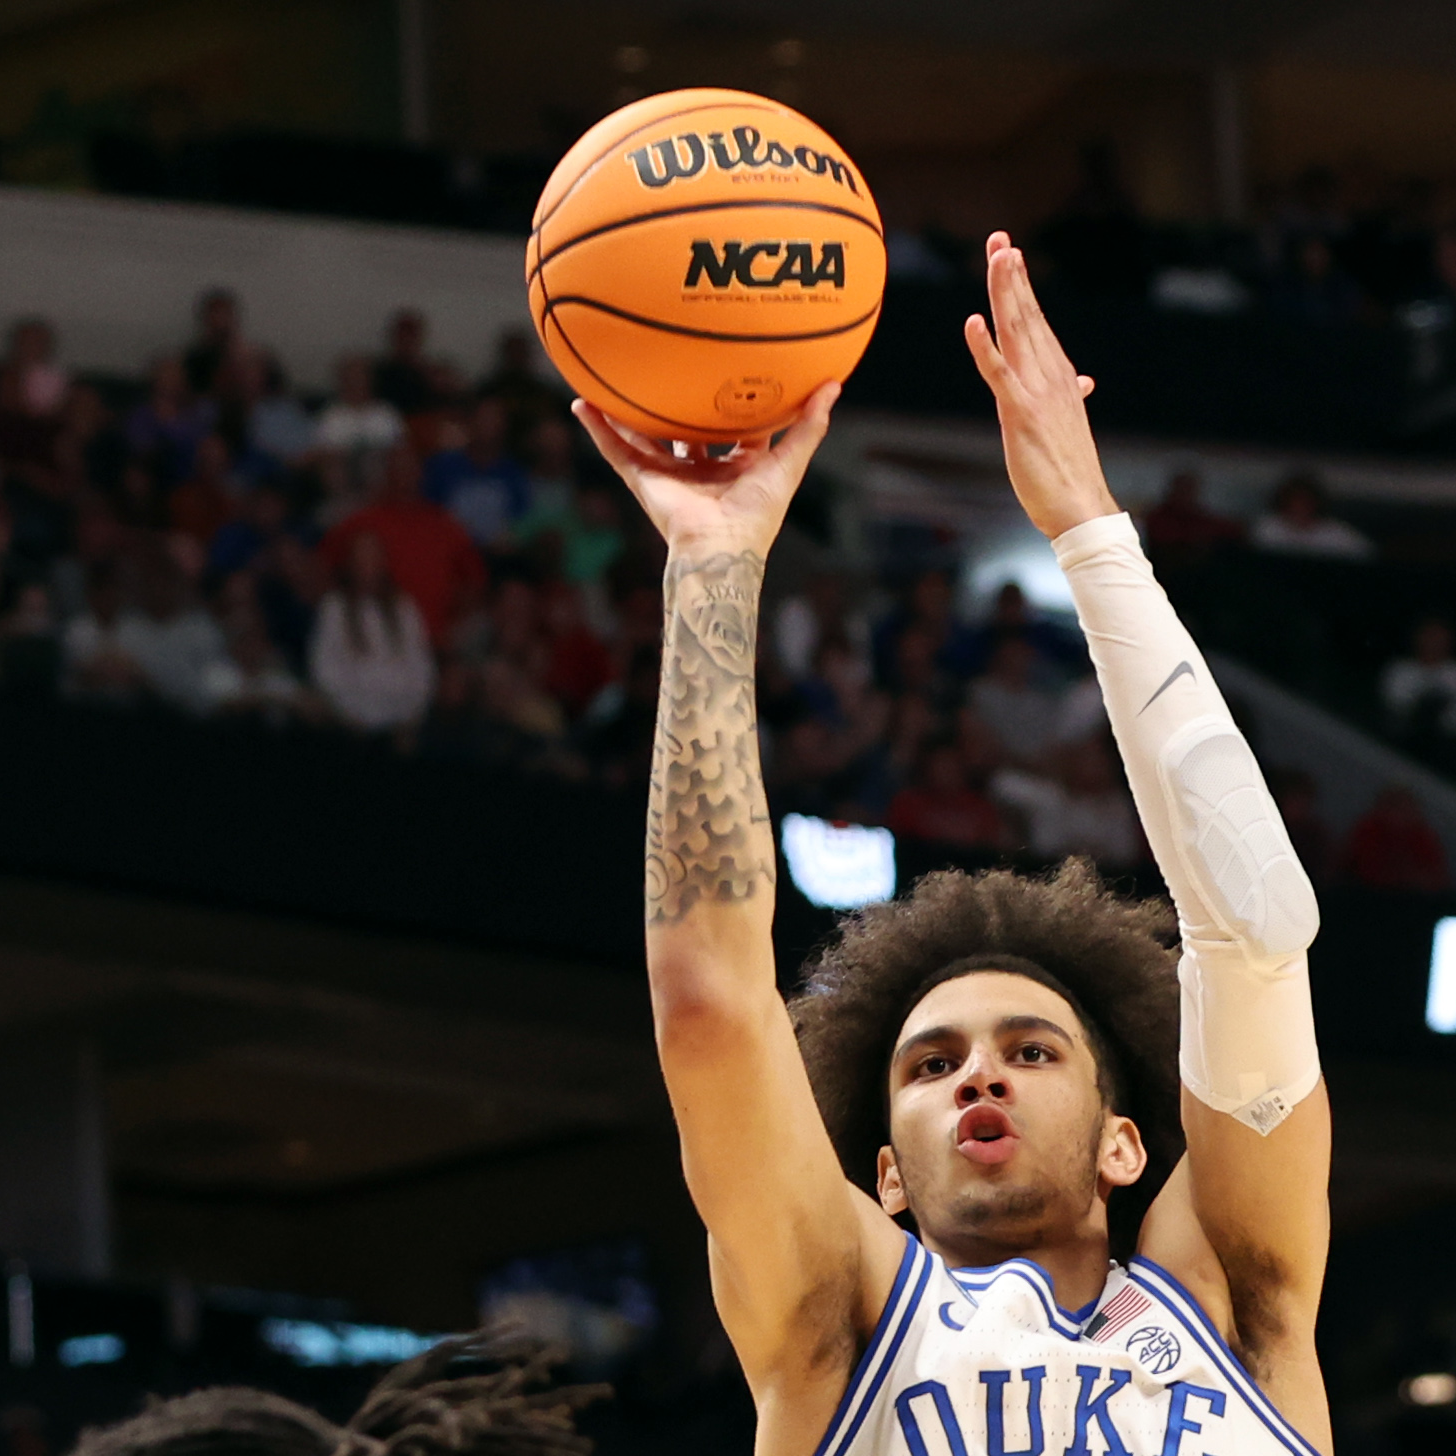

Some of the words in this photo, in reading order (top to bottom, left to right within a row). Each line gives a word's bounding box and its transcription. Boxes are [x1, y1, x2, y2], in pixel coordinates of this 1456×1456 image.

[625, 125, 862, 198] Wilson
[682, 240, 846, 289] NCAA
[1139, 1331, 1172, 1362] ACC
